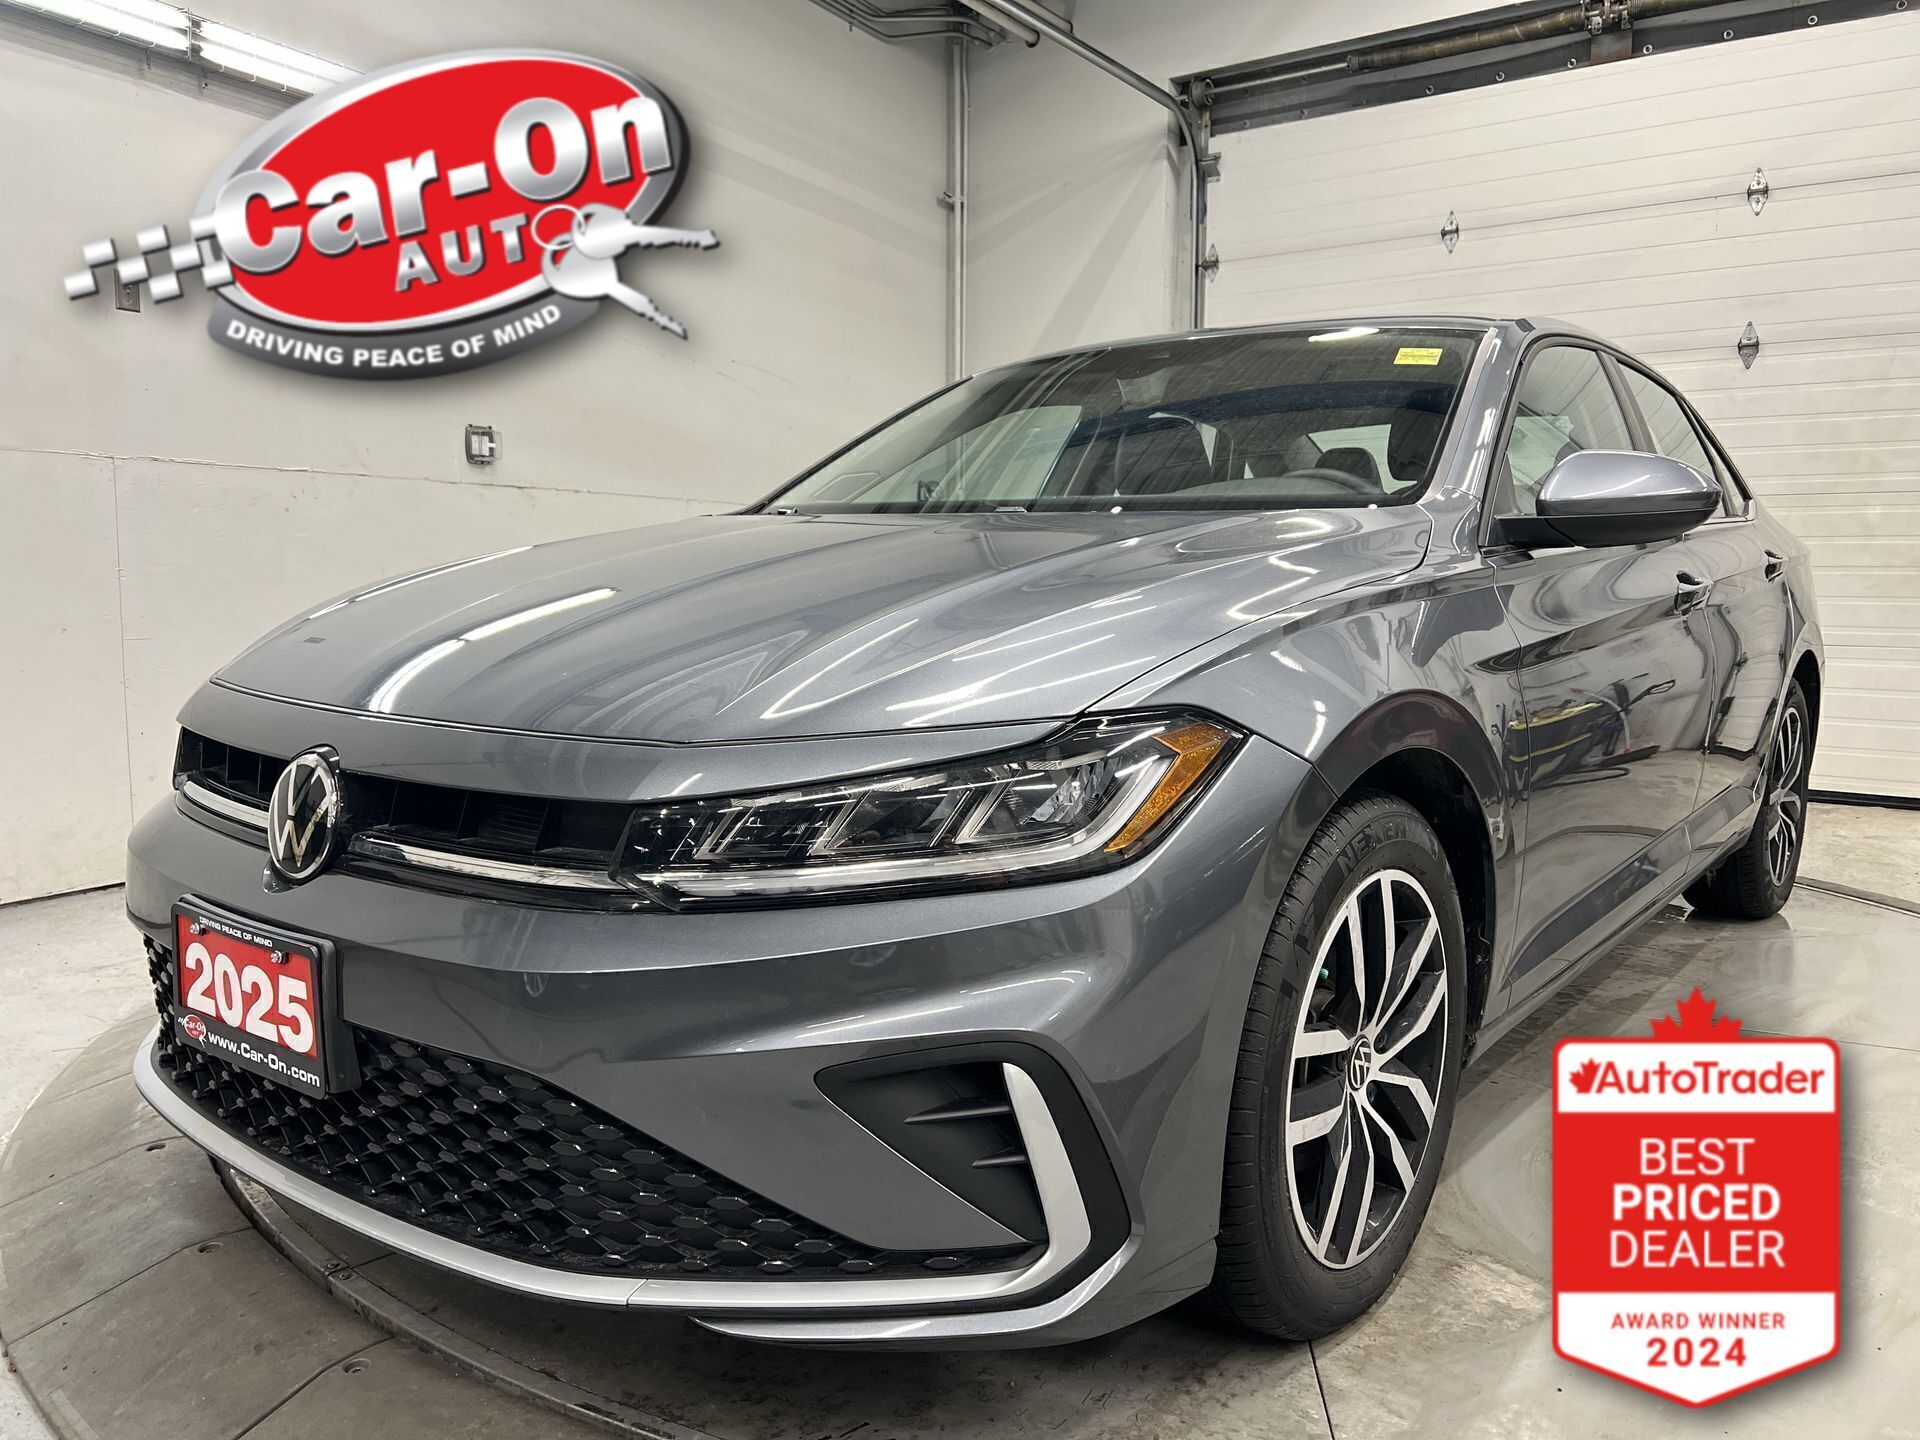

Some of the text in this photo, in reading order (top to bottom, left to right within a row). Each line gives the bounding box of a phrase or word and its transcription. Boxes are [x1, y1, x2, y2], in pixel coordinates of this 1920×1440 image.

[199, 915, 273, 948] DRIVING PEACE OF MIND
[185, 941, 314, 1054] 2025
[207, 1031, 321, 1088] www.Car-On.com
